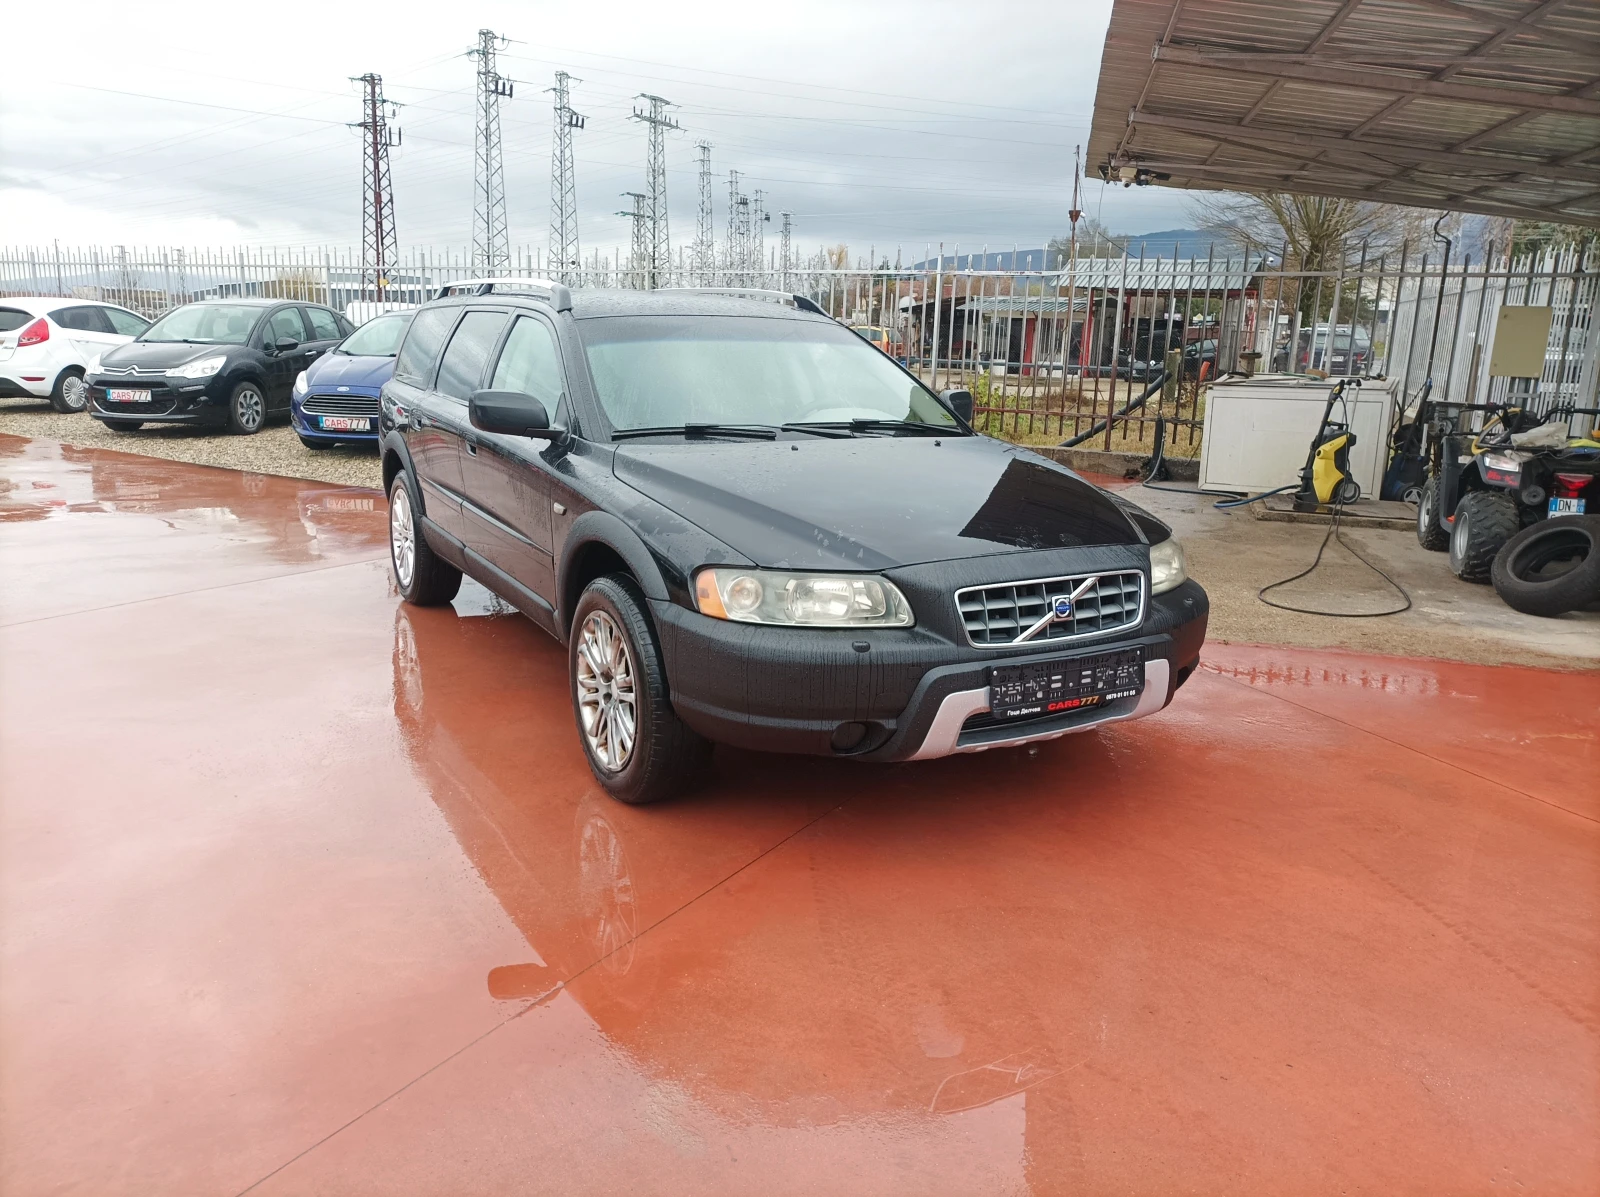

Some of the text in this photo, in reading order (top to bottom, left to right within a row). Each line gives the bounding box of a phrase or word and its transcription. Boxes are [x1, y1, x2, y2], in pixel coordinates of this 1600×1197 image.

[111, 390, 150, 400] CARS777
[324, 418, 368, 429] CARS777
[1048, 696, 1099, 711] CARS777
